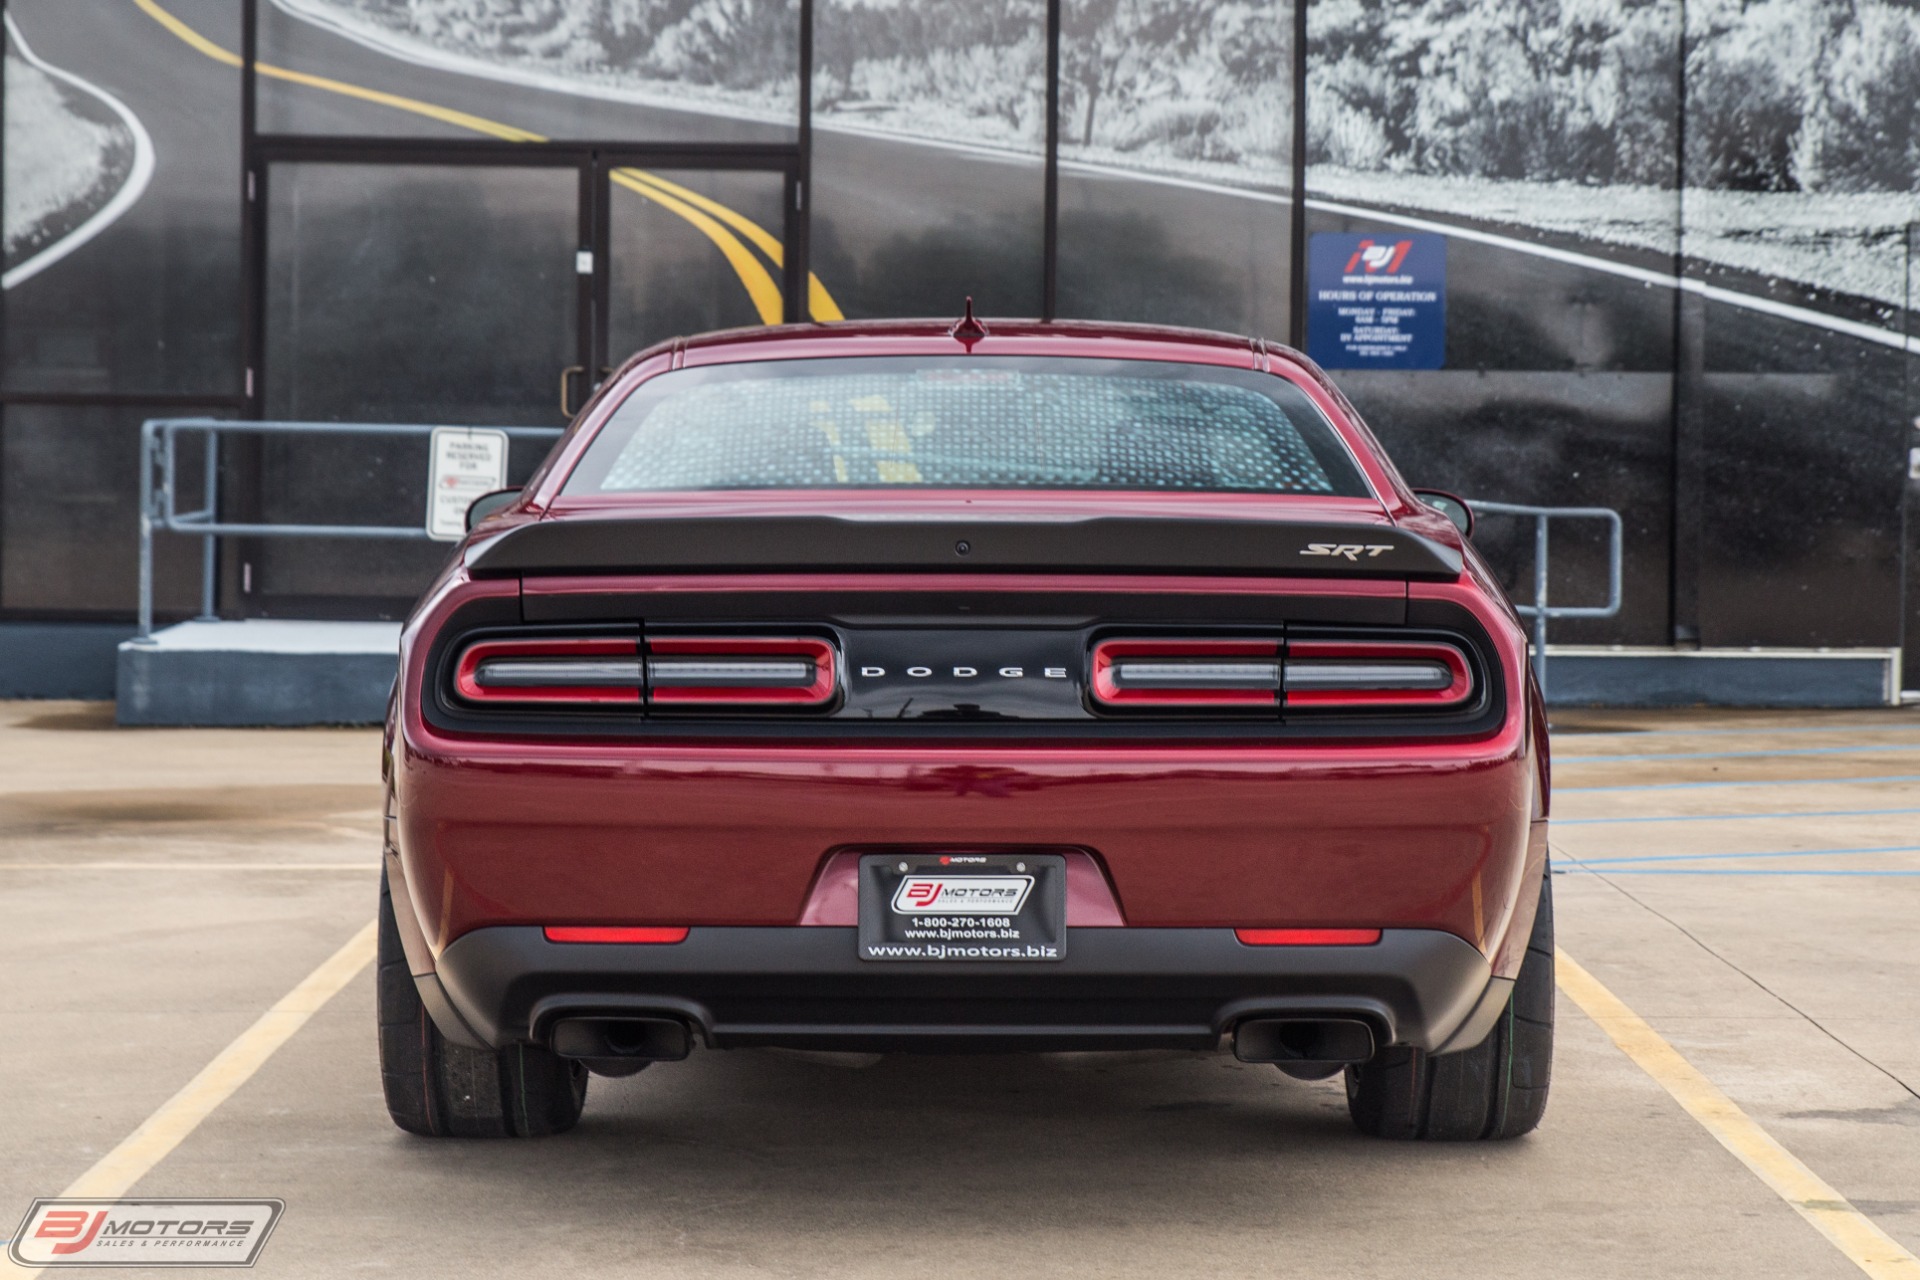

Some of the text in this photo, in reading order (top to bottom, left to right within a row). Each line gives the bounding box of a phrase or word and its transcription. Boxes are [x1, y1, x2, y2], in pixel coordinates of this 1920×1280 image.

[1318, 290, 1437, 302] HOURS OF OPERATION
[449, 443, 489, 451] PARKING
[446, 452, 491, 461] RESERVED
[459, 461, 477, 470] FOR
[1299, 543, 1395, 561] SRT
[861, 666, 1067, 678] DODGE
[906, 883, 1018, 907] BJ MOTORS
[912, 917, 1010, 928] 1-800-270-1608
[905, 929, 1020, 940] www.bjmotors.biz
[868, 945, 1058, 959] www.bjmotors.biz
